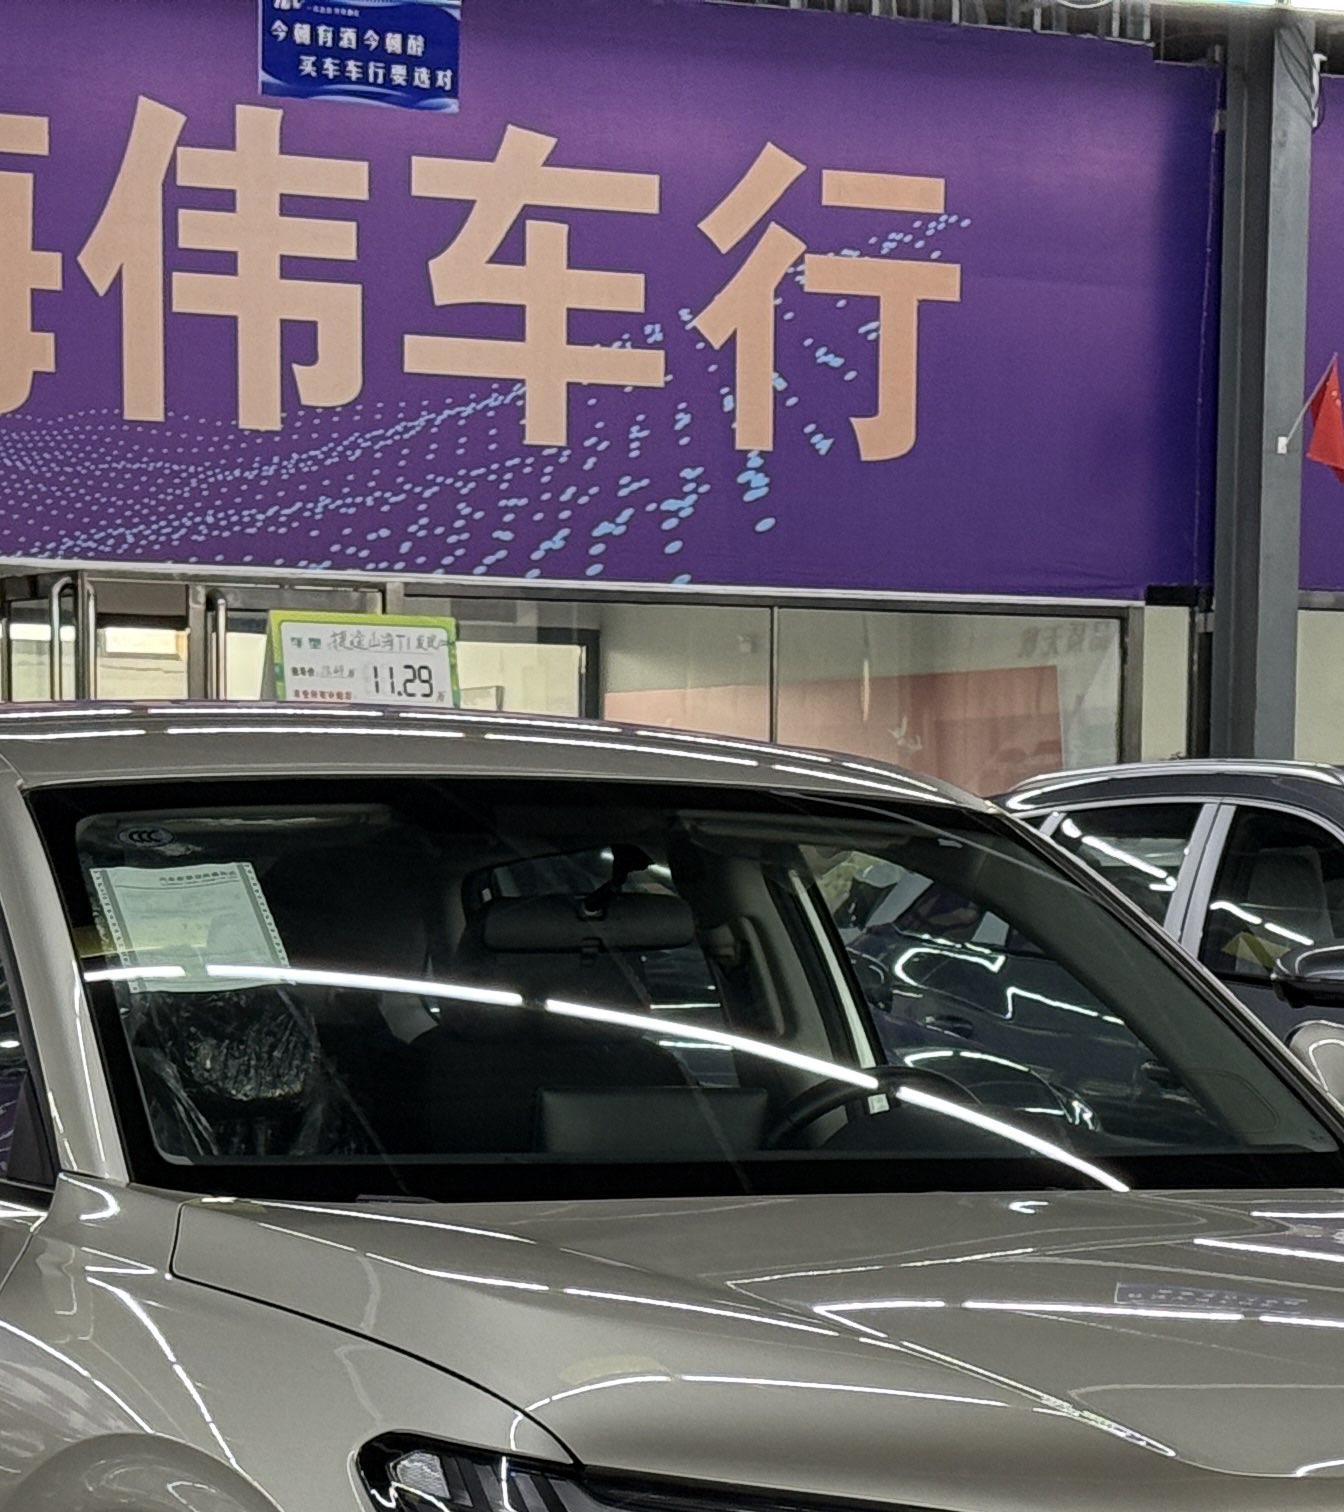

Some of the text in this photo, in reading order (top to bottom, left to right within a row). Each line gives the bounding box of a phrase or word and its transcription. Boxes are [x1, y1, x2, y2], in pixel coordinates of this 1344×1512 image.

[298, 55, 453, 91] 买车车行要选对
[372, 664, 434, 698] 11.29
